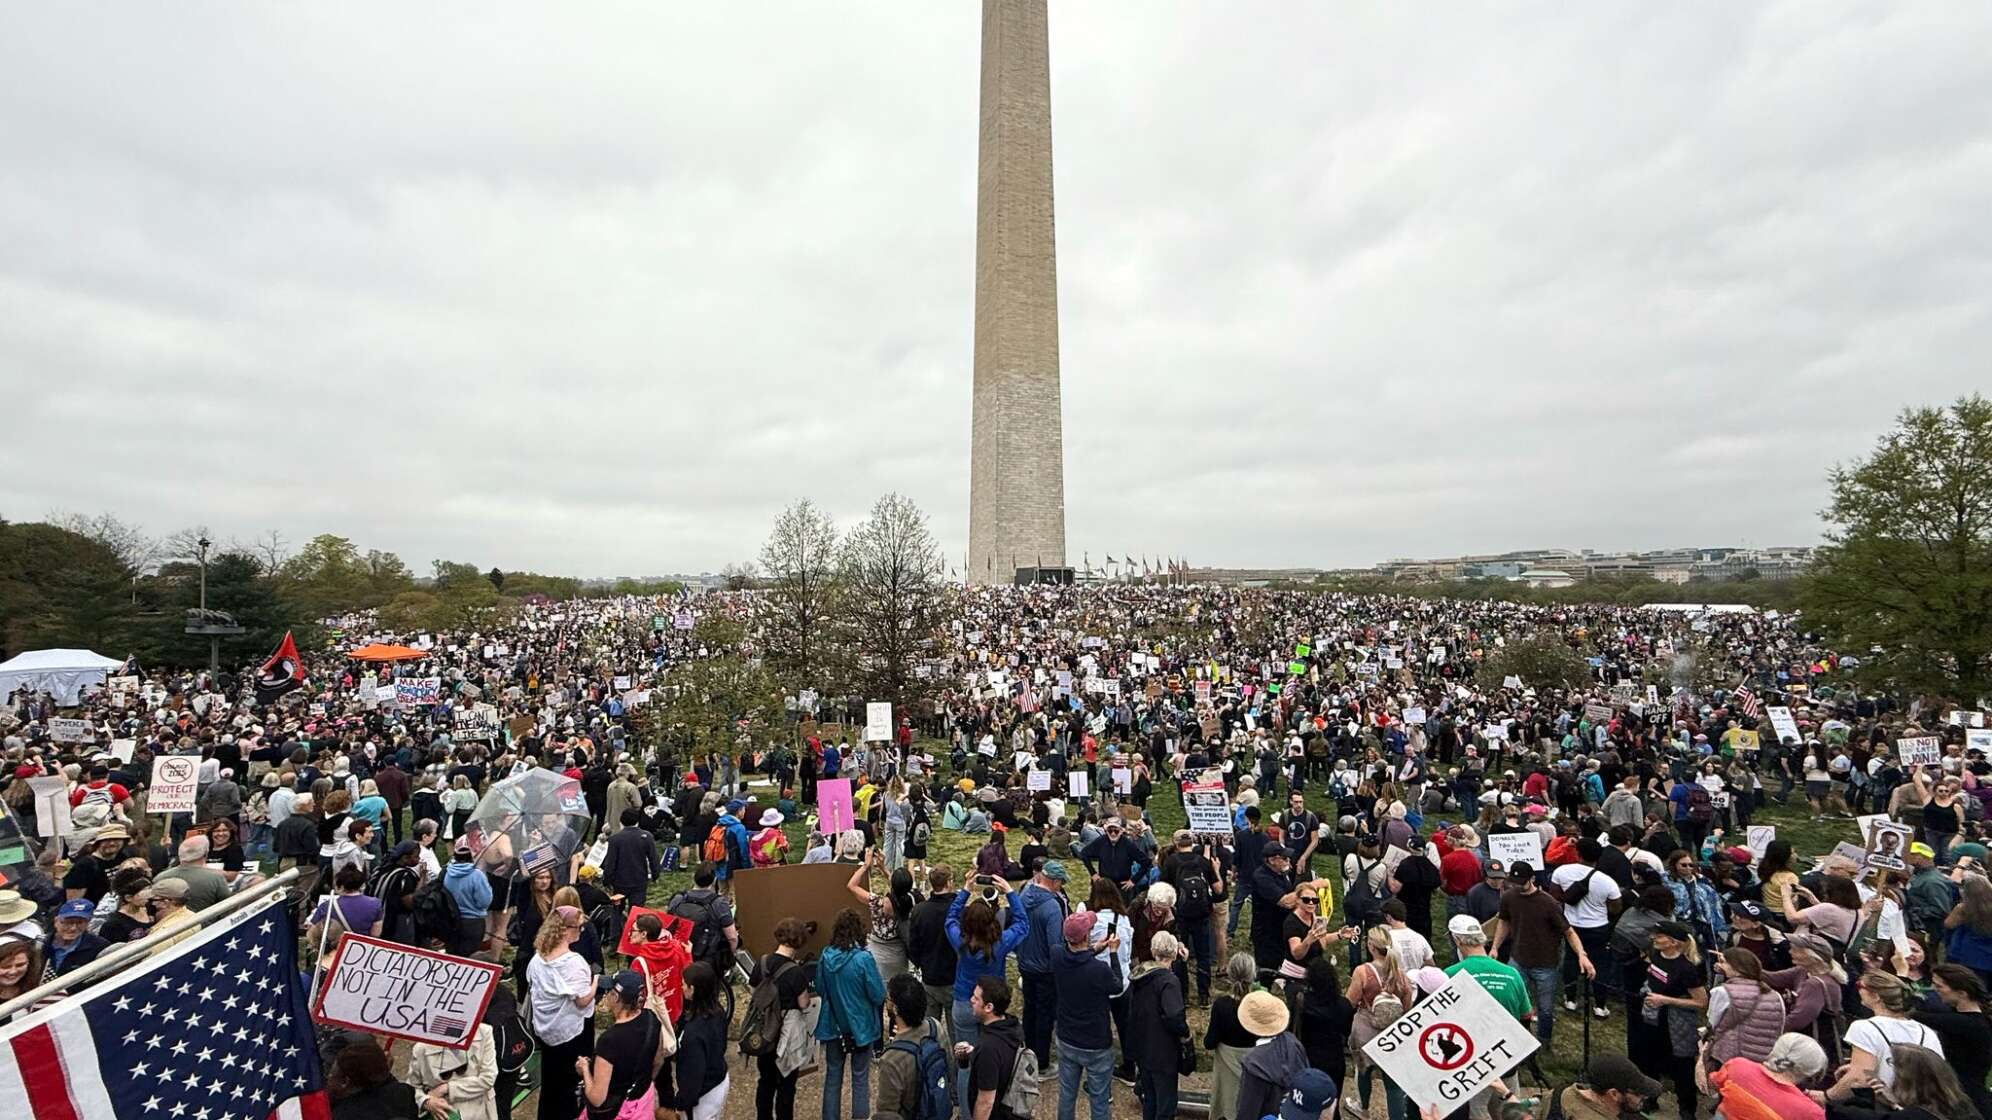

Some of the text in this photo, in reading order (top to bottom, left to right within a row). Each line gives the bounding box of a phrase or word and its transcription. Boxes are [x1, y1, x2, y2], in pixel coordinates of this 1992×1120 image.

[400, 679, 433, 689] MAKE
[1649, 713, 1668, 723] OFF
[1916, 738, 1936, 746] NOT
[151, 784, 196, 795] PROTECT
[147, 801, 194, 810] DEMOCRACY
[343, 942, 491, 992] DICTATORSHIP
[333, 966, 470, 1014] NOT IN THE
[360, 998, 428, 1033] USA
[1377, 986, 1461, 1053] STOP THE
[1438, 1038, 1513, 1101] GRIFT
